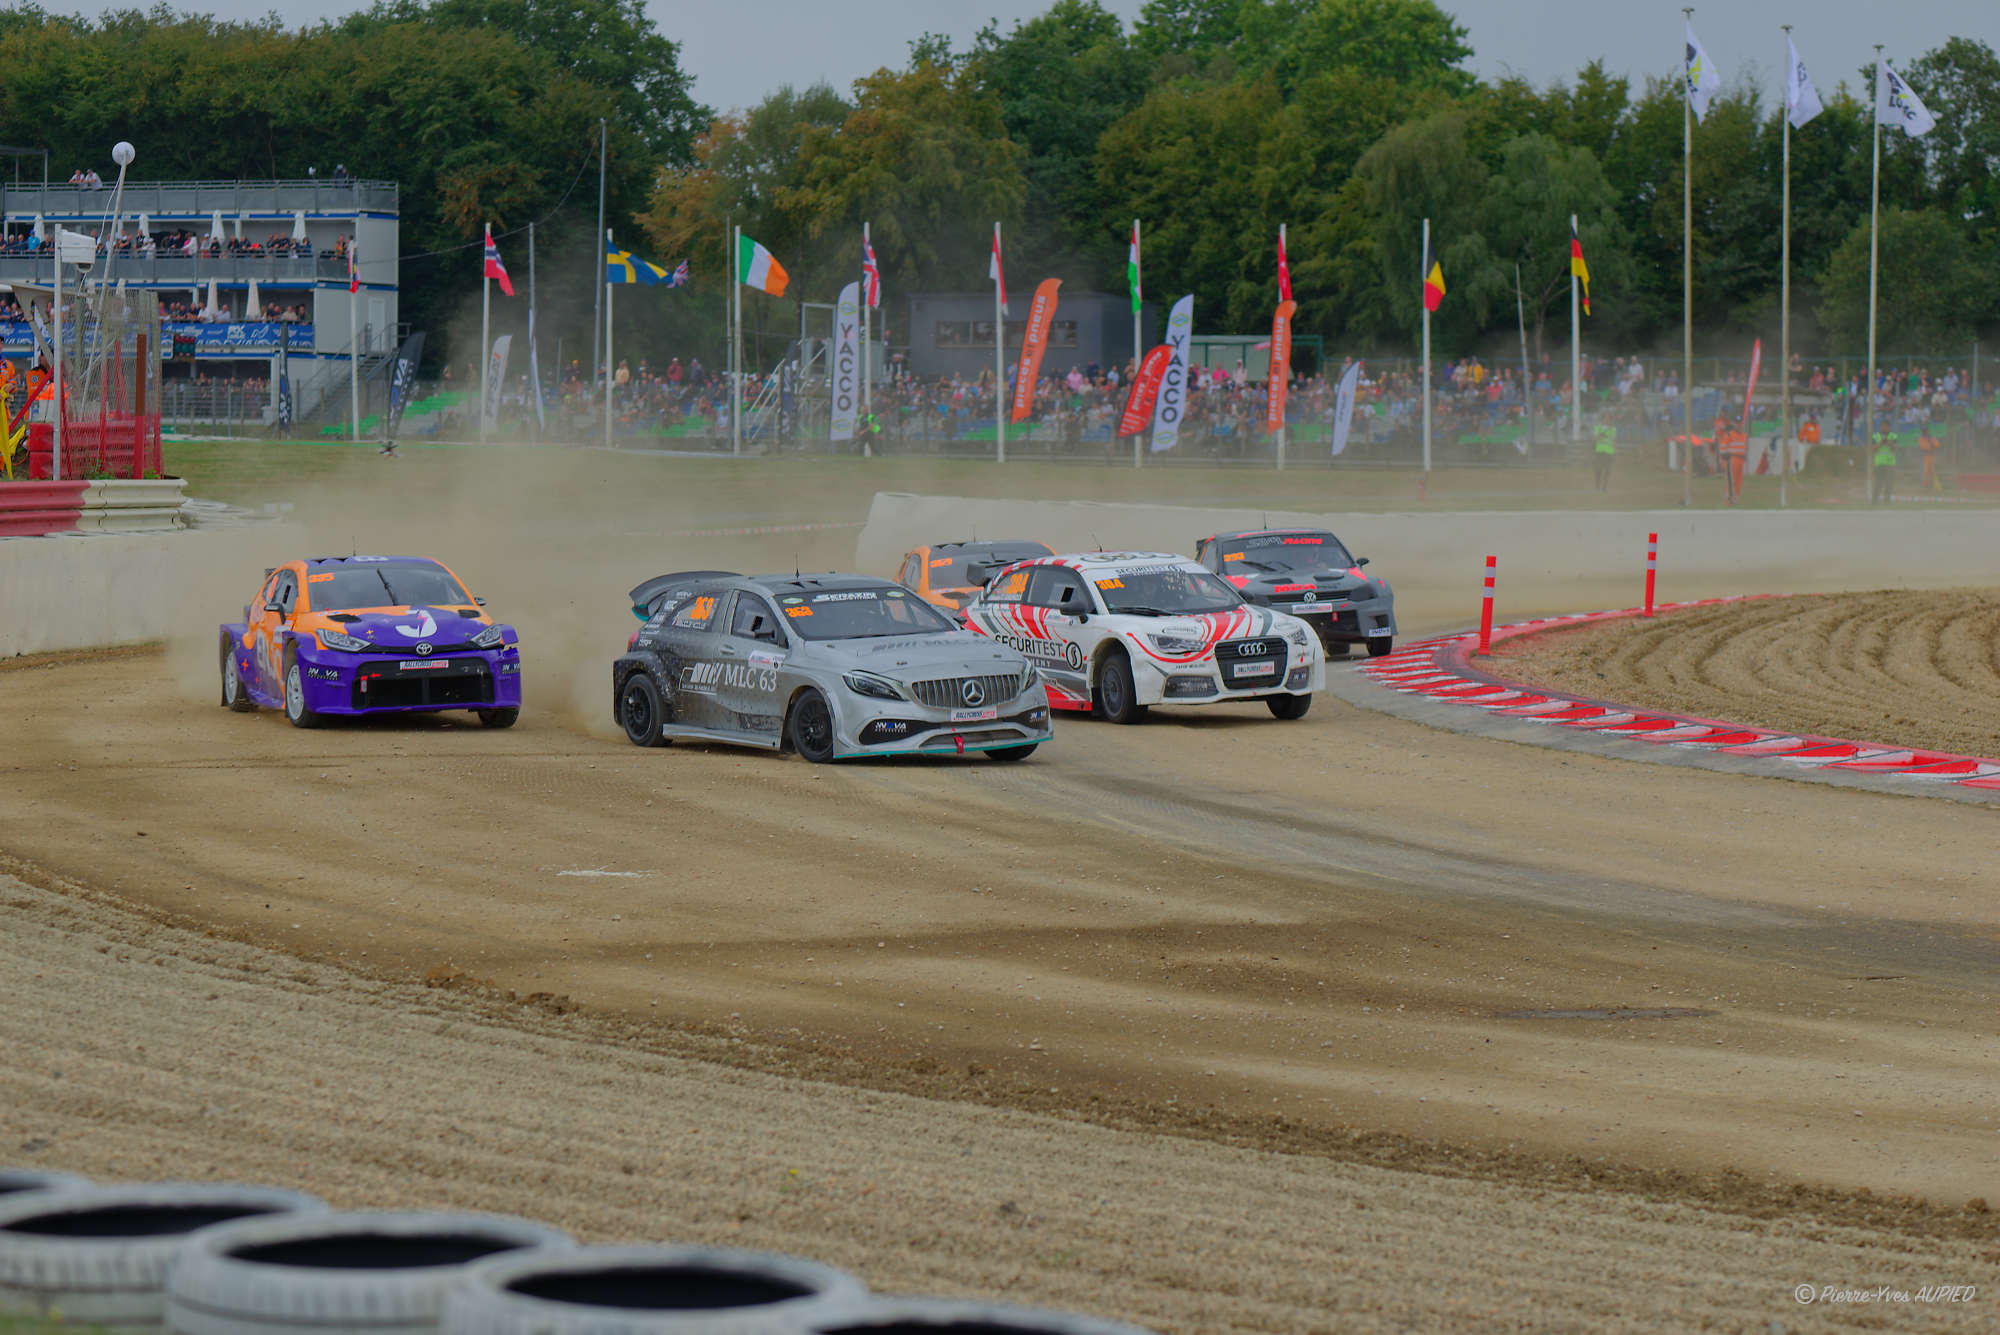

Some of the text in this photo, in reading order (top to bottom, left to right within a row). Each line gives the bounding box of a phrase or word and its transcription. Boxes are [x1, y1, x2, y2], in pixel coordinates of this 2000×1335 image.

[837, 322, 854, 412] YACCO
[1161, 335, 1185, 423] YACCO
[1007, 573, 1030, 595] 304
[1096, 578, 1125, 590] 304
[690, 596, 715, 621] 363
[785, 606, 814, 618] 363
[995, 634, 1063, 657] SECURITEST
[724, 663, 777, 692] MLC 63
